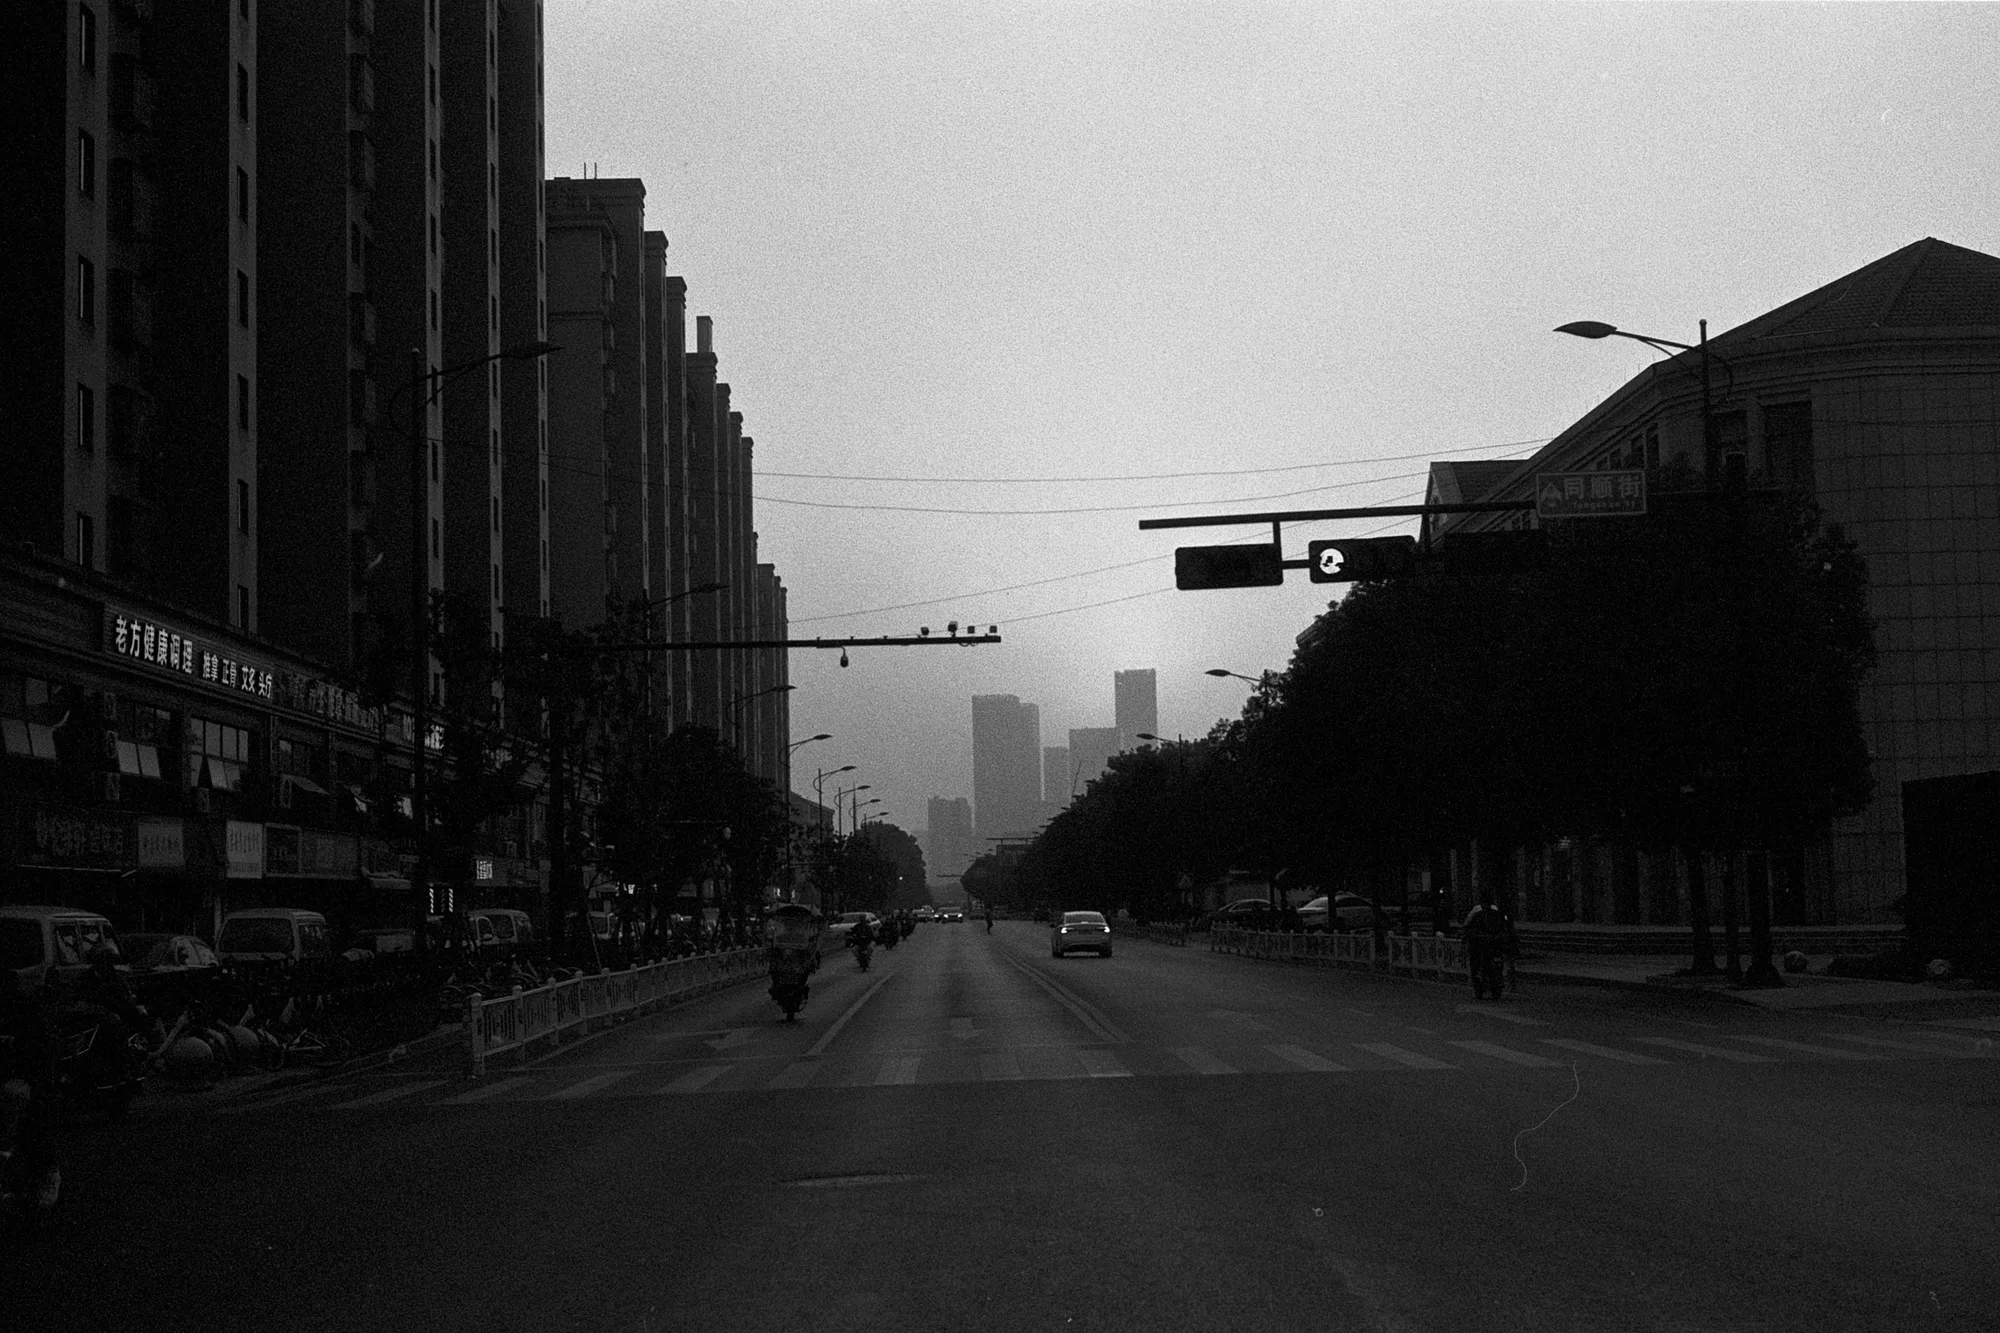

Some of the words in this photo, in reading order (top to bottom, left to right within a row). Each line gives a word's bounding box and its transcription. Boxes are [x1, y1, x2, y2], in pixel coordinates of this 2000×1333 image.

[1564, 475, 1640, 500] 同顺街
[116, 615, 193, 674] 老方健康调理
[203, 650, 218, 681] 推拿
[222, 658, 237, 688] 正骨
[241, 664, 256, 693] 艾灸
